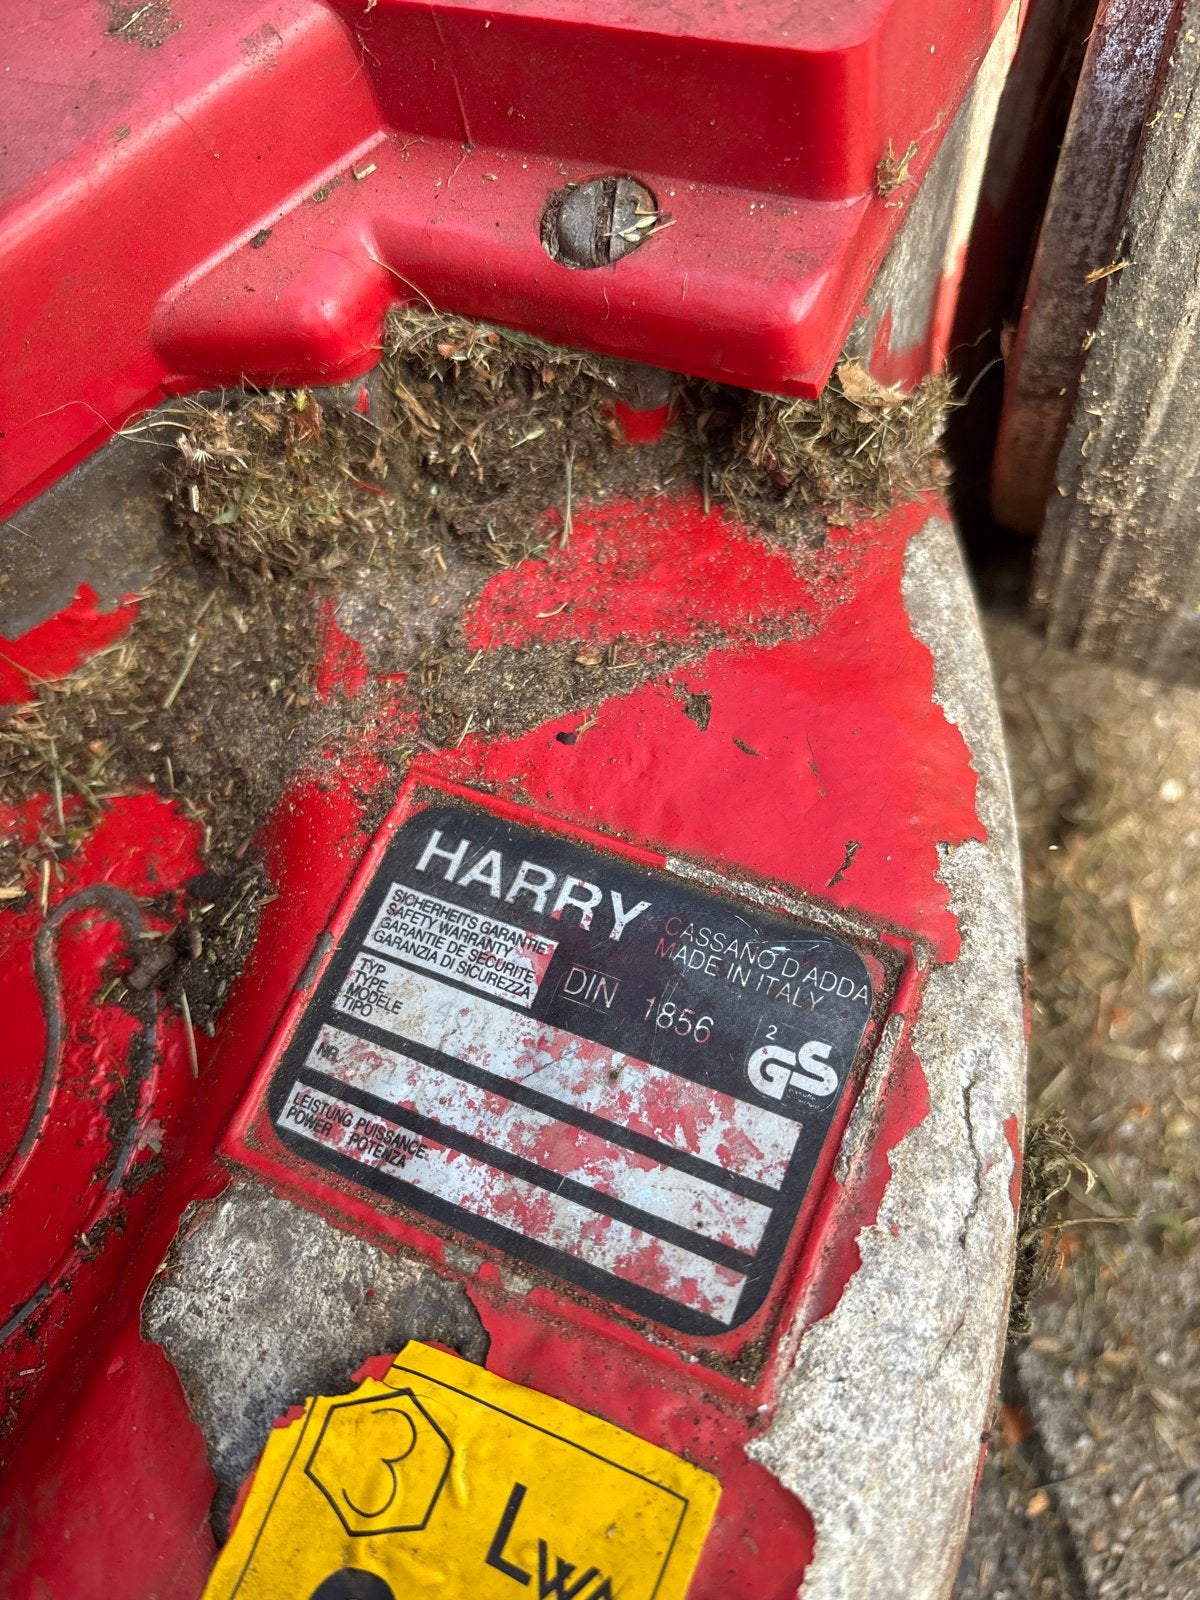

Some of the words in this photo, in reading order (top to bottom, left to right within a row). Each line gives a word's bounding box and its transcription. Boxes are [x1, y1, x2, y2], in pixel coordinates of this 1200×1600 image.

[415, 829, 652, 942] HARRY
[380, 916, 447, 950] GARANTIE
[446, 940, 464, 958] DE
[467, 952, 537, 985] SECURITE
[386, 902, 439, 929] SAFETY
[439, 923, 515, 958] WARRANTY
[392, 889, 479, 930] SICHERHEITS
[480, 921, 549, 956] GARANTIE
[664, 916, 776, 970] CASSANO
[354, 969, 389, 994] TYPE
[360, 957, 387, 976] TYP
[373, 930, 438, 964] GARANZIA
[440, 955, 456, 970] DI
[456, 962, 531, 1000] SICUREZZA
[654, 937, 722, 978] MADE
[727, 965, 752, 988] IN
[756, 974, 825, 1011] ITALY
[342, 994, 373, 1017] TIPO
[346, 982, 403, 1015] MODELE
[563, 967, 619, 1009] DIN
[643, 995, 714, 1044] 1856
[765, 1025, 778, 1041] 2
[747, 1040, 839, 1100] GS
[286, 1106, 333, 1137] POWER
[348, 1132, 407, 1170] POTENZA
[293, 1091, 354, 1128] LEISTUNG
[354, 1117, 428, 1159] PUISSANCE
[341, 1407, 417, 1519] 3
